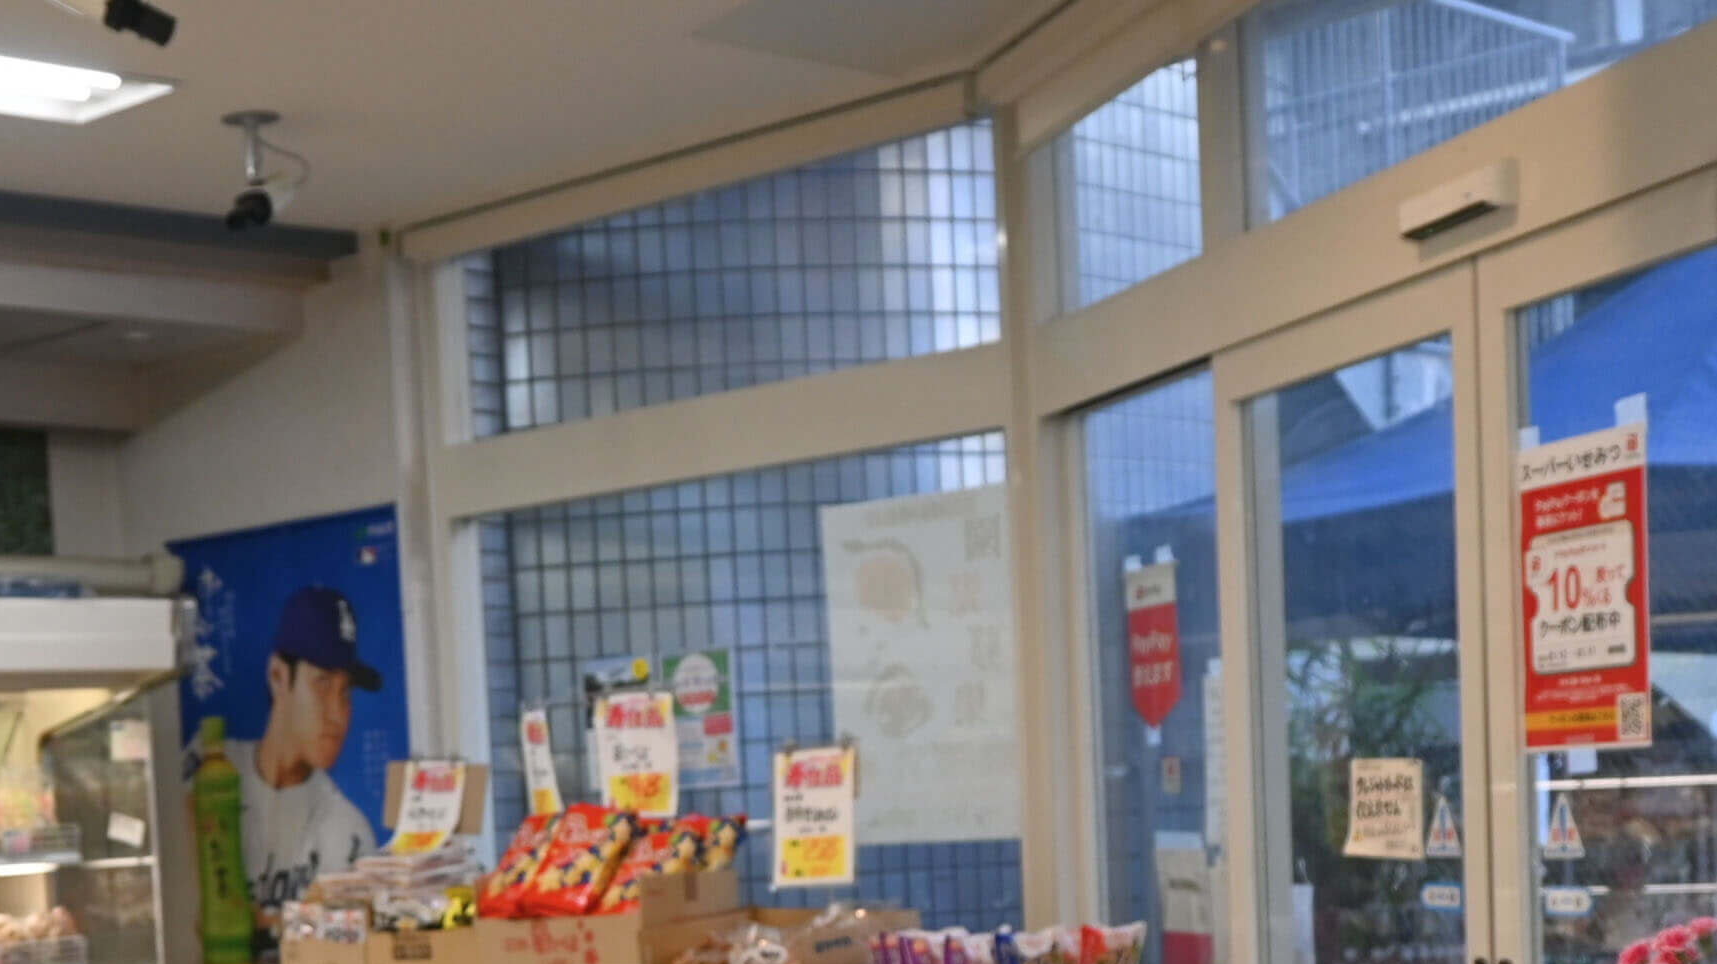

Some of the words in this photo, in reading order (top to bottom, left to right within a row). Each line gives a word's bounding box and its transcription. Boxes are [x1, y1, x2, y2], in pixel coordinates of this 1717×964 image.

[1522, 444, 1622, 481] スーパーいせみつ
[1540, 611, 1621, 639] クーポン配布中
